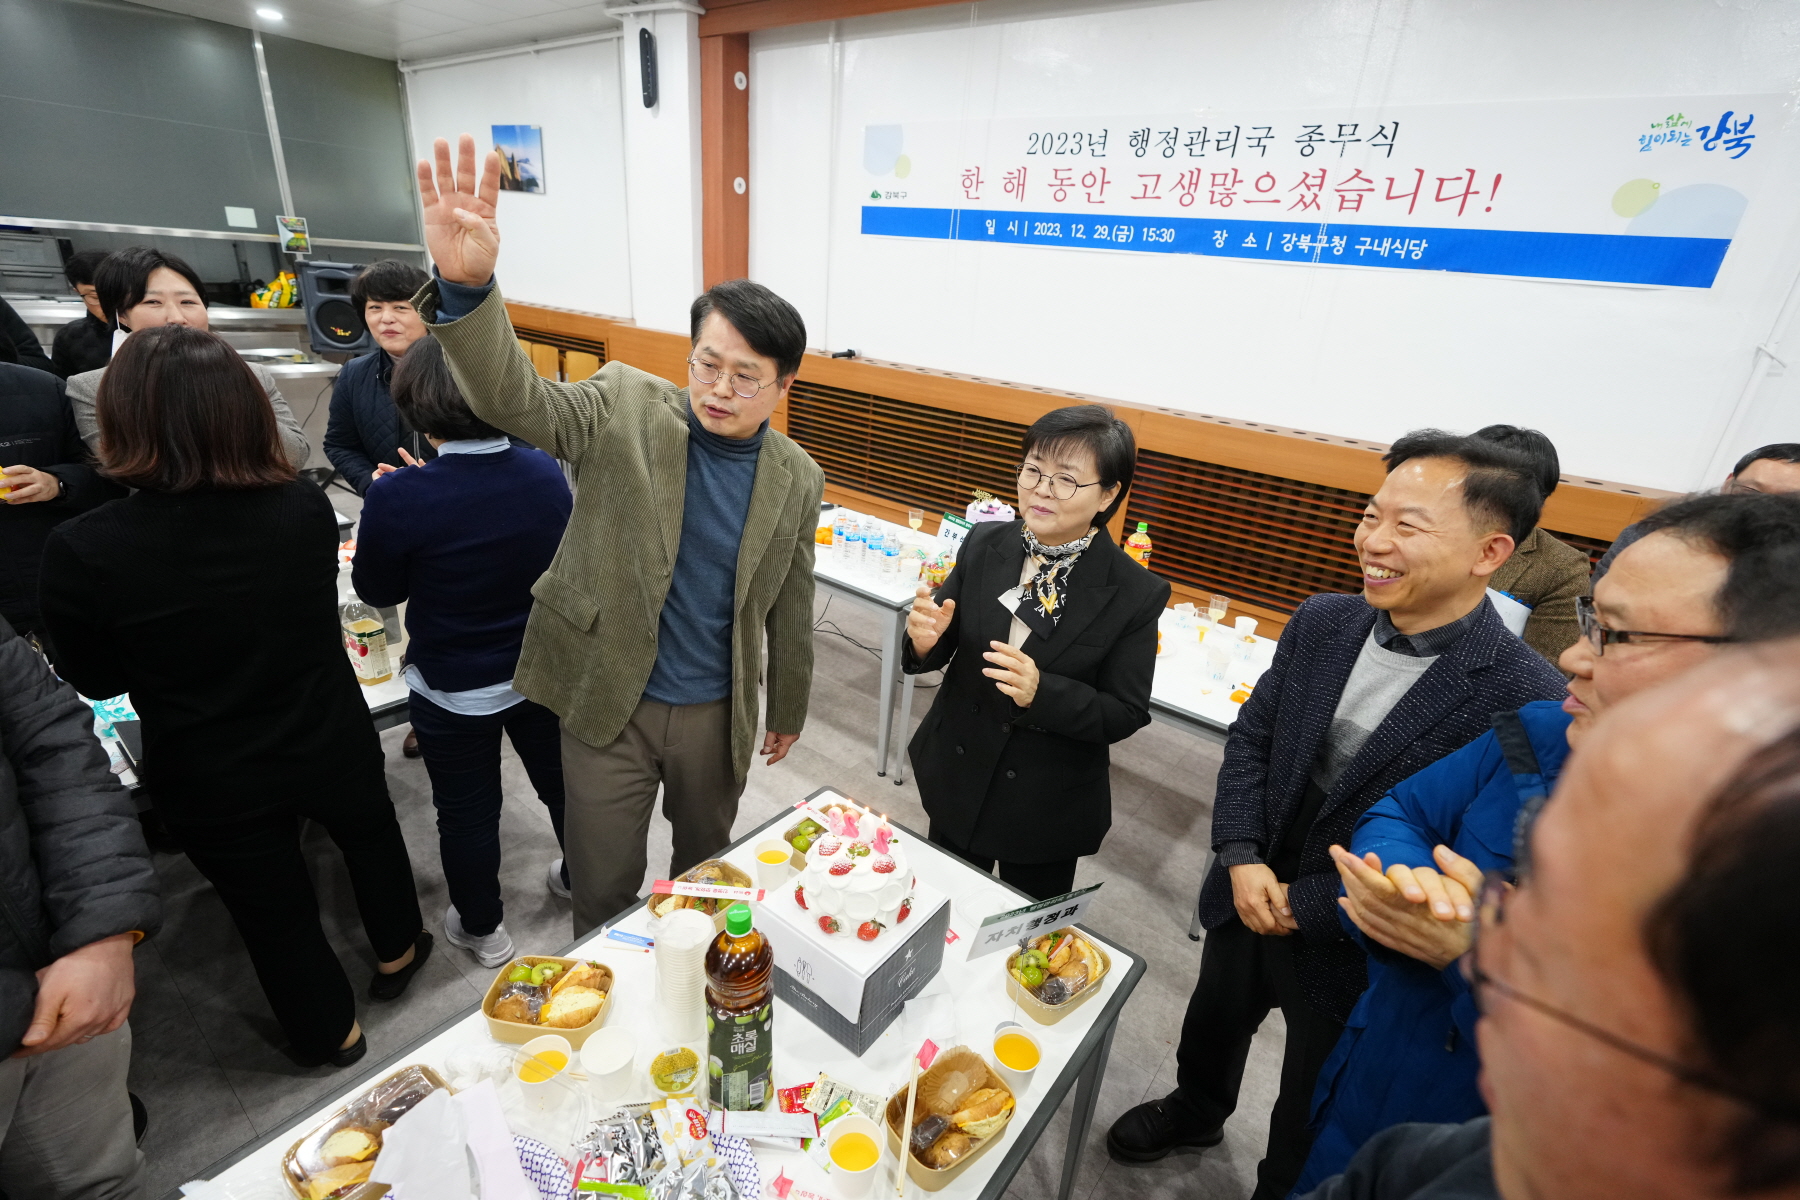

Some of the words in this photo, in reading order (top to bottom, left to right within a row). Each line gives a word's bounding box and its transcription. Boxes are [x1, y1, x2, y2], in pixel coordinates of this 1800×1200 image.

[1026, 128, 1109, 158] 2023년
[1128, 125, 1276, 159] 행정관리국
[1294, 121, 1400, 158] 종무식
[1695, 110, 1756, 160] 강북
[885, 191, 908, 200] 강북구
[961, 165, 985, 200] 한
[1002, 165, 1028, 203] 해
[1047, 166, 1112, 204] 동안
[1130, 166, 1503, 218] 고생많으셨습니다!
[985, 218, 996, 236] 일
[1033, 222, 1063, 239] 2023.
[1070, 223, 1087, 240] 12.
[1093, 225, 1135, 243] 29.(금)
[1142, 226, 1176, 243] 15:30
[1212, 229, 1229, 249] 장
[1241, 232, 1258, 248] 소
[1280, 232, 1347, 256] 강북구청
[1354, 236, 1429, 260] 구내식당
[984, 903, 1080, 945] 자치행정과
[730, 1040, 758, 1056] 매실
[731, 1029, 758, 1045] 초록
